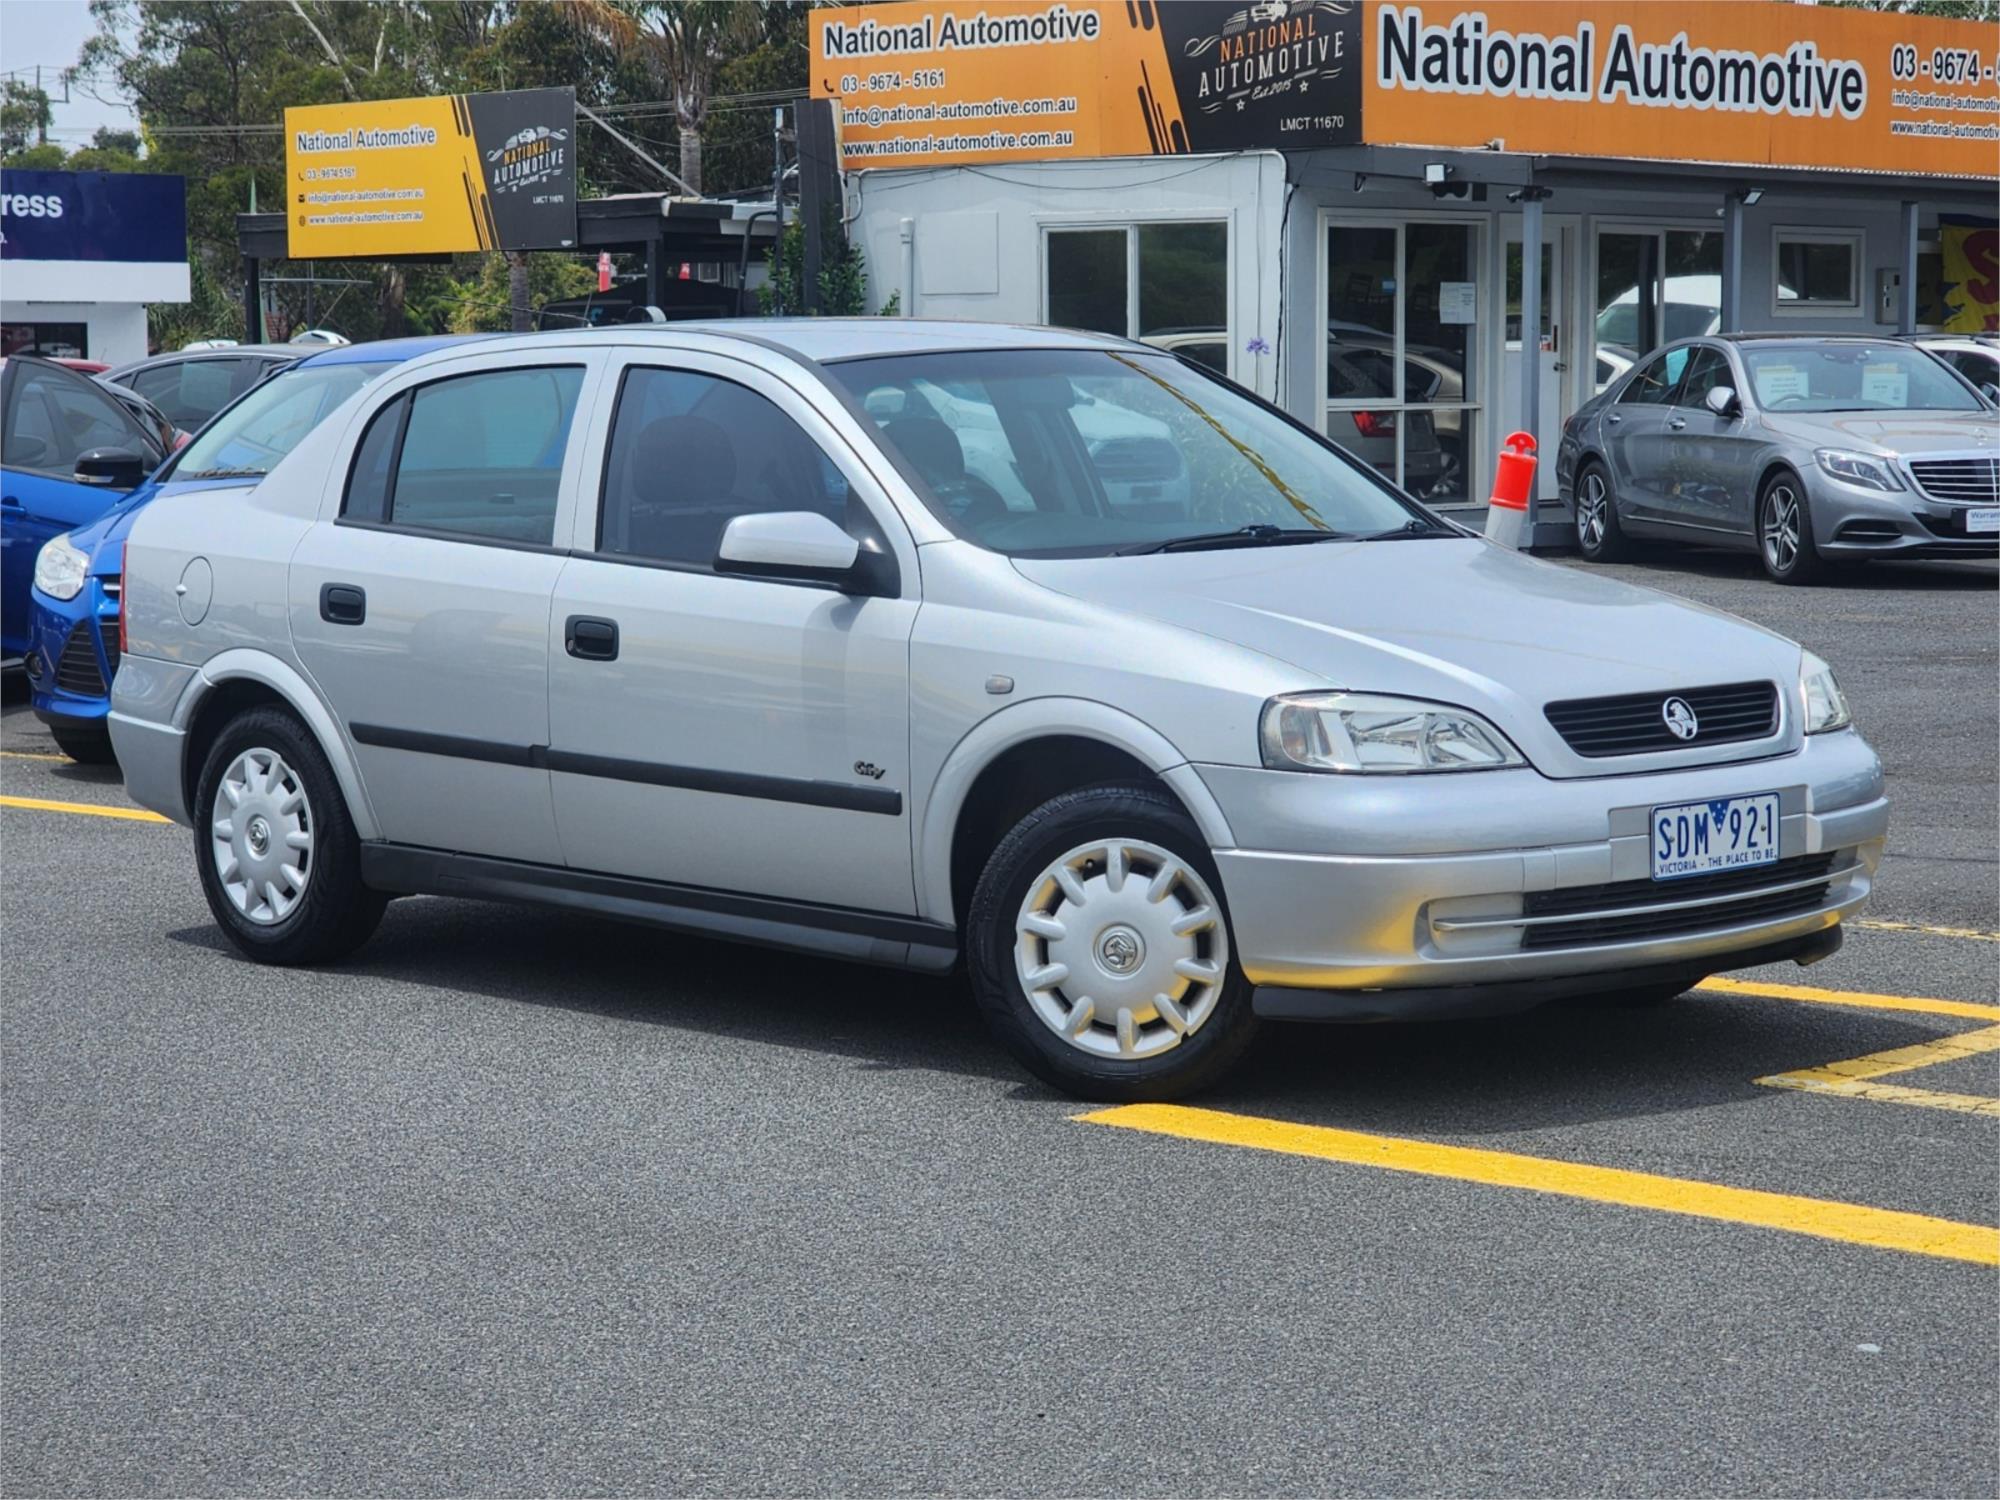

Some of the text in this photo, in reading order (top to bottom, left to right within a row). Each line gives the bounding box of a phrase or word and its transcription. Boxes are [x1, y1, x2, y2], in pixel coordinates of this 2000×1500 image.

[825, 7, 1098, 56] National Automotive
[1219, 13, 1317, 63] NATIONAL
[1198, 30, 1345, 99] AUTOMOTIVE
[1382, 13, 1864, 113] National Automotive
[1893, 47, 1916, 78] 03
[1933, 50, 1979, 82] 9674
[841, 76, 858, 92] 03
[869, 74, 901, 91] 9674
[913, 71, 945, 88] 5161
[842, 98, 1076, 127] info@national-automotive.com.au
[1280, 115, 1345, 131] LMCT 11670
[297, 125, 436, 152] National Automotive
[504, 138, 551, 165] NATIONAL
[843, 132, 1073, 156] www.national-automotive.com.au
[493, 148, 564, 185] AUTOMOTIVE
[0, 193, 64, 218] ress
[1658, 803, 1772, 861] SDM 921
[1659, 859, 1698, 875] VICTORIA
[1708, 856, 1723, 867] THE
[1726, 852, 1749, 864] PLACE
[1752, 850, 1762, 860] TO
